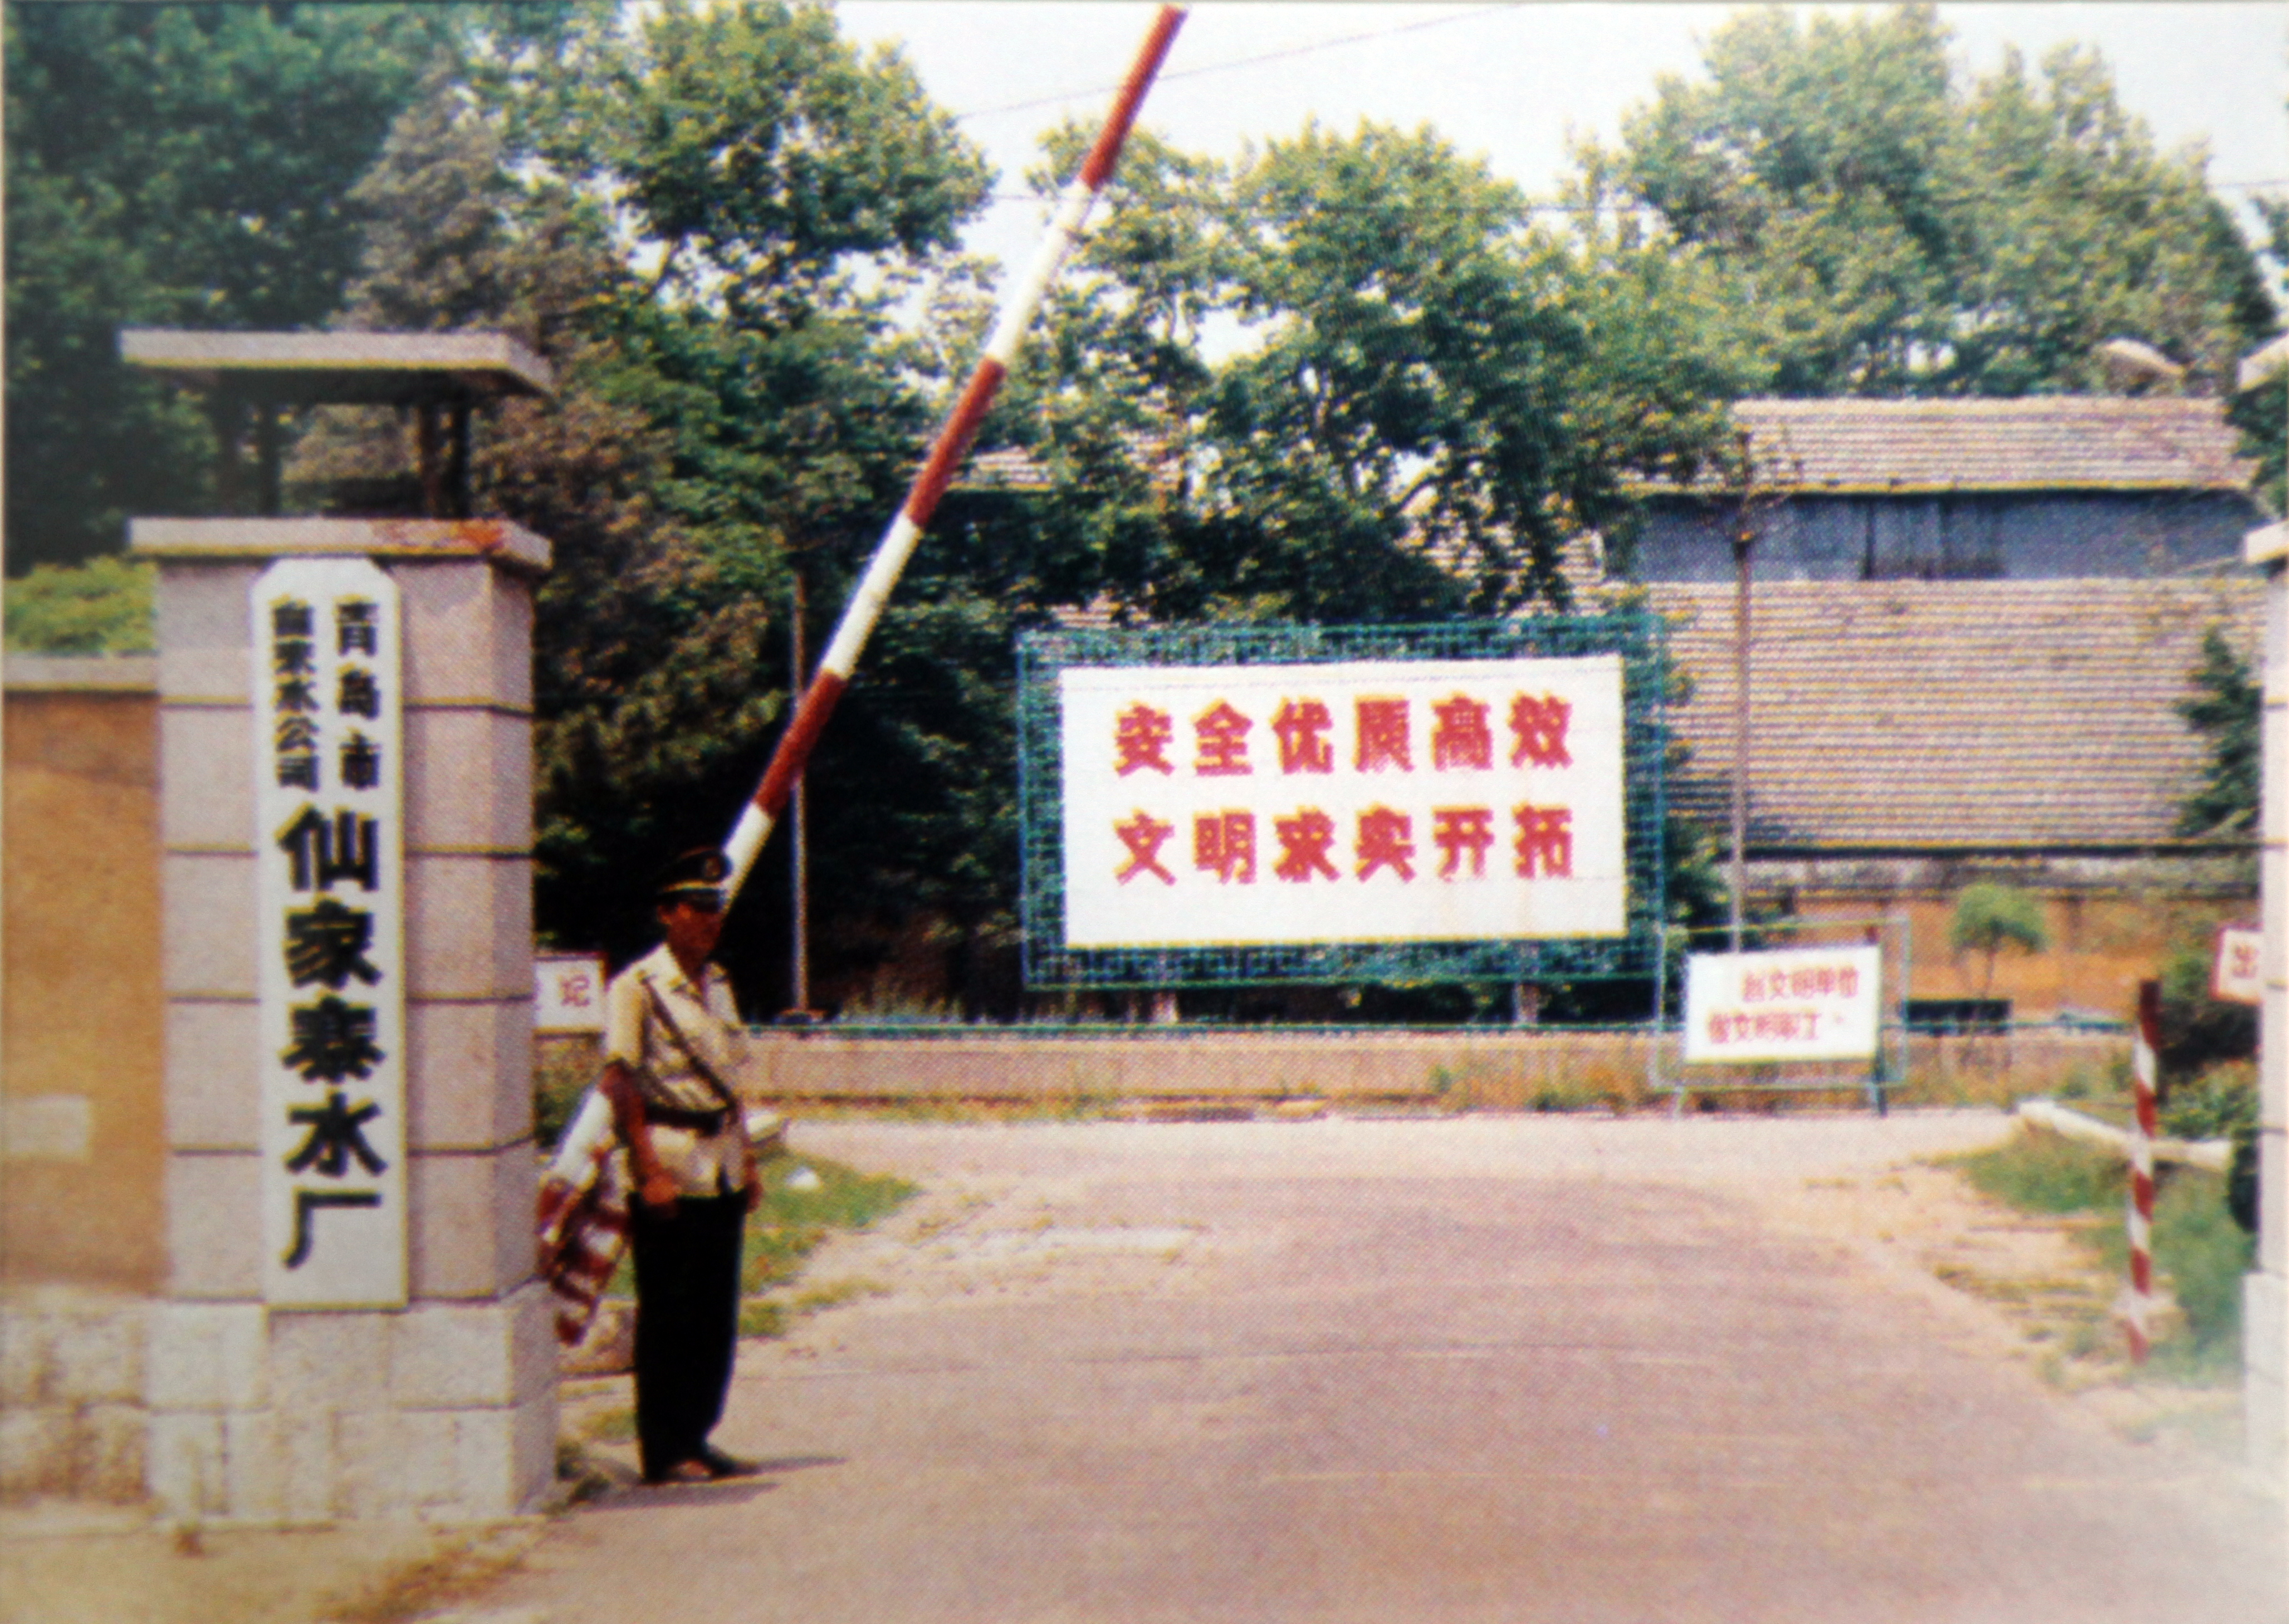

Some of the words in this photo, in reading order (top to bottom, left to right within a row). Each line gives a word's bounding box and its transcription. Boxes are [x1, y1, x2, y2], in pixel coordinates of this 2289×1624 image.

[271, 594, 320, 793] 自来水公司
[1114, 689, 1573, 777] 安全优质高效
[1114, 801, 1573, 886] 文明求实开拓
[275, 803, 387, 1270] 仙家寨水厂
